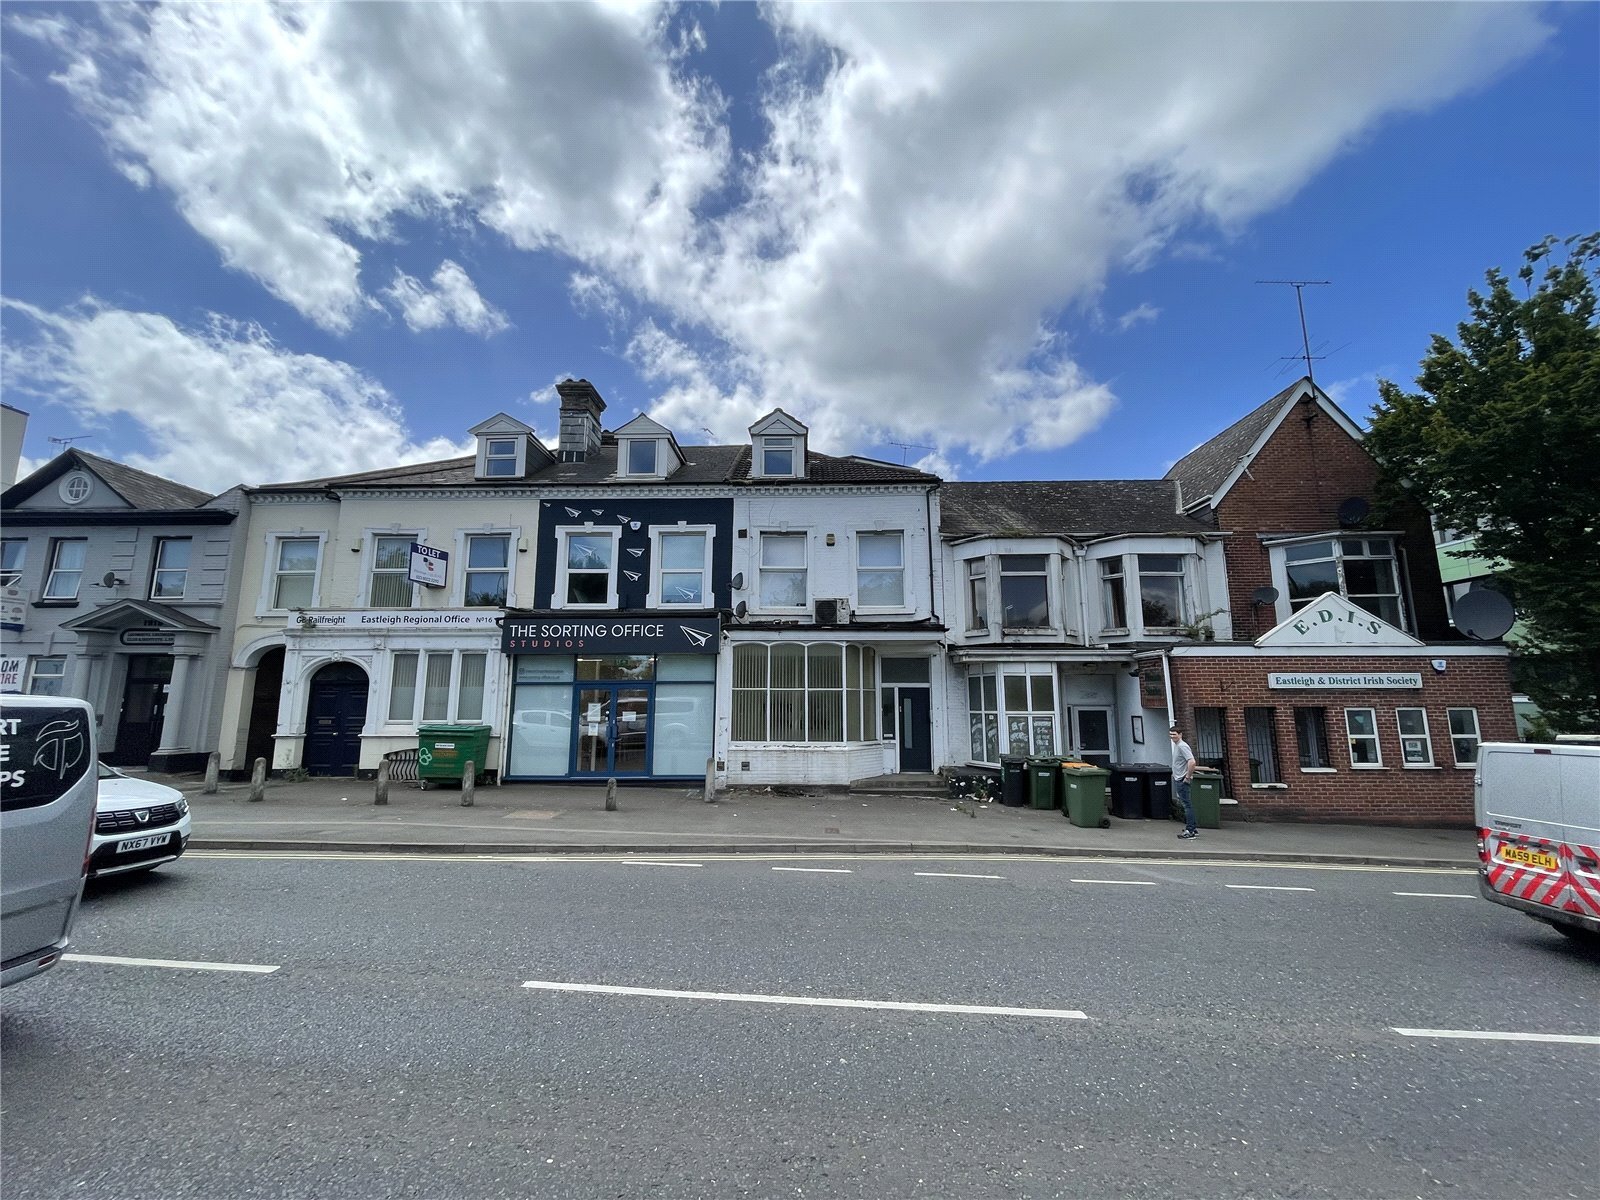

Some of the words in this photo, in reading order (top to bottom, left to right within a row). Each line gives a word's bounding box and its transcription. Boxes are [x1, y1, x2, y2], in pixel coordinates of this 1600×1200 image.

[417, 545, 428, 555] TO
[428, 548, 441, 558] LET
[308, 615, 346, 625] Railfreight
[361, 615, 401, 625] Eastleigh
[403, 615, 442, 625] Regional
[444, 615, 471, 624] Office
[509, 625, 537, 637] THE
[540, 624, 607, 638] SORTING
[611, 624, 664, 637] OFFICE
[509, 640, 584, 648] STUDIOS
[1275, 676, 1315, 686] Eastleigh
[1317, 676, 1326, 685] &
[1328, 676, 1361, 685] District
[1363, 676, 1384, 685] Irish
[1386, 676, 1418, 686] Society
[121, 838, 149, 850] NX67
[1531, 854, 1552, 867] ELH
